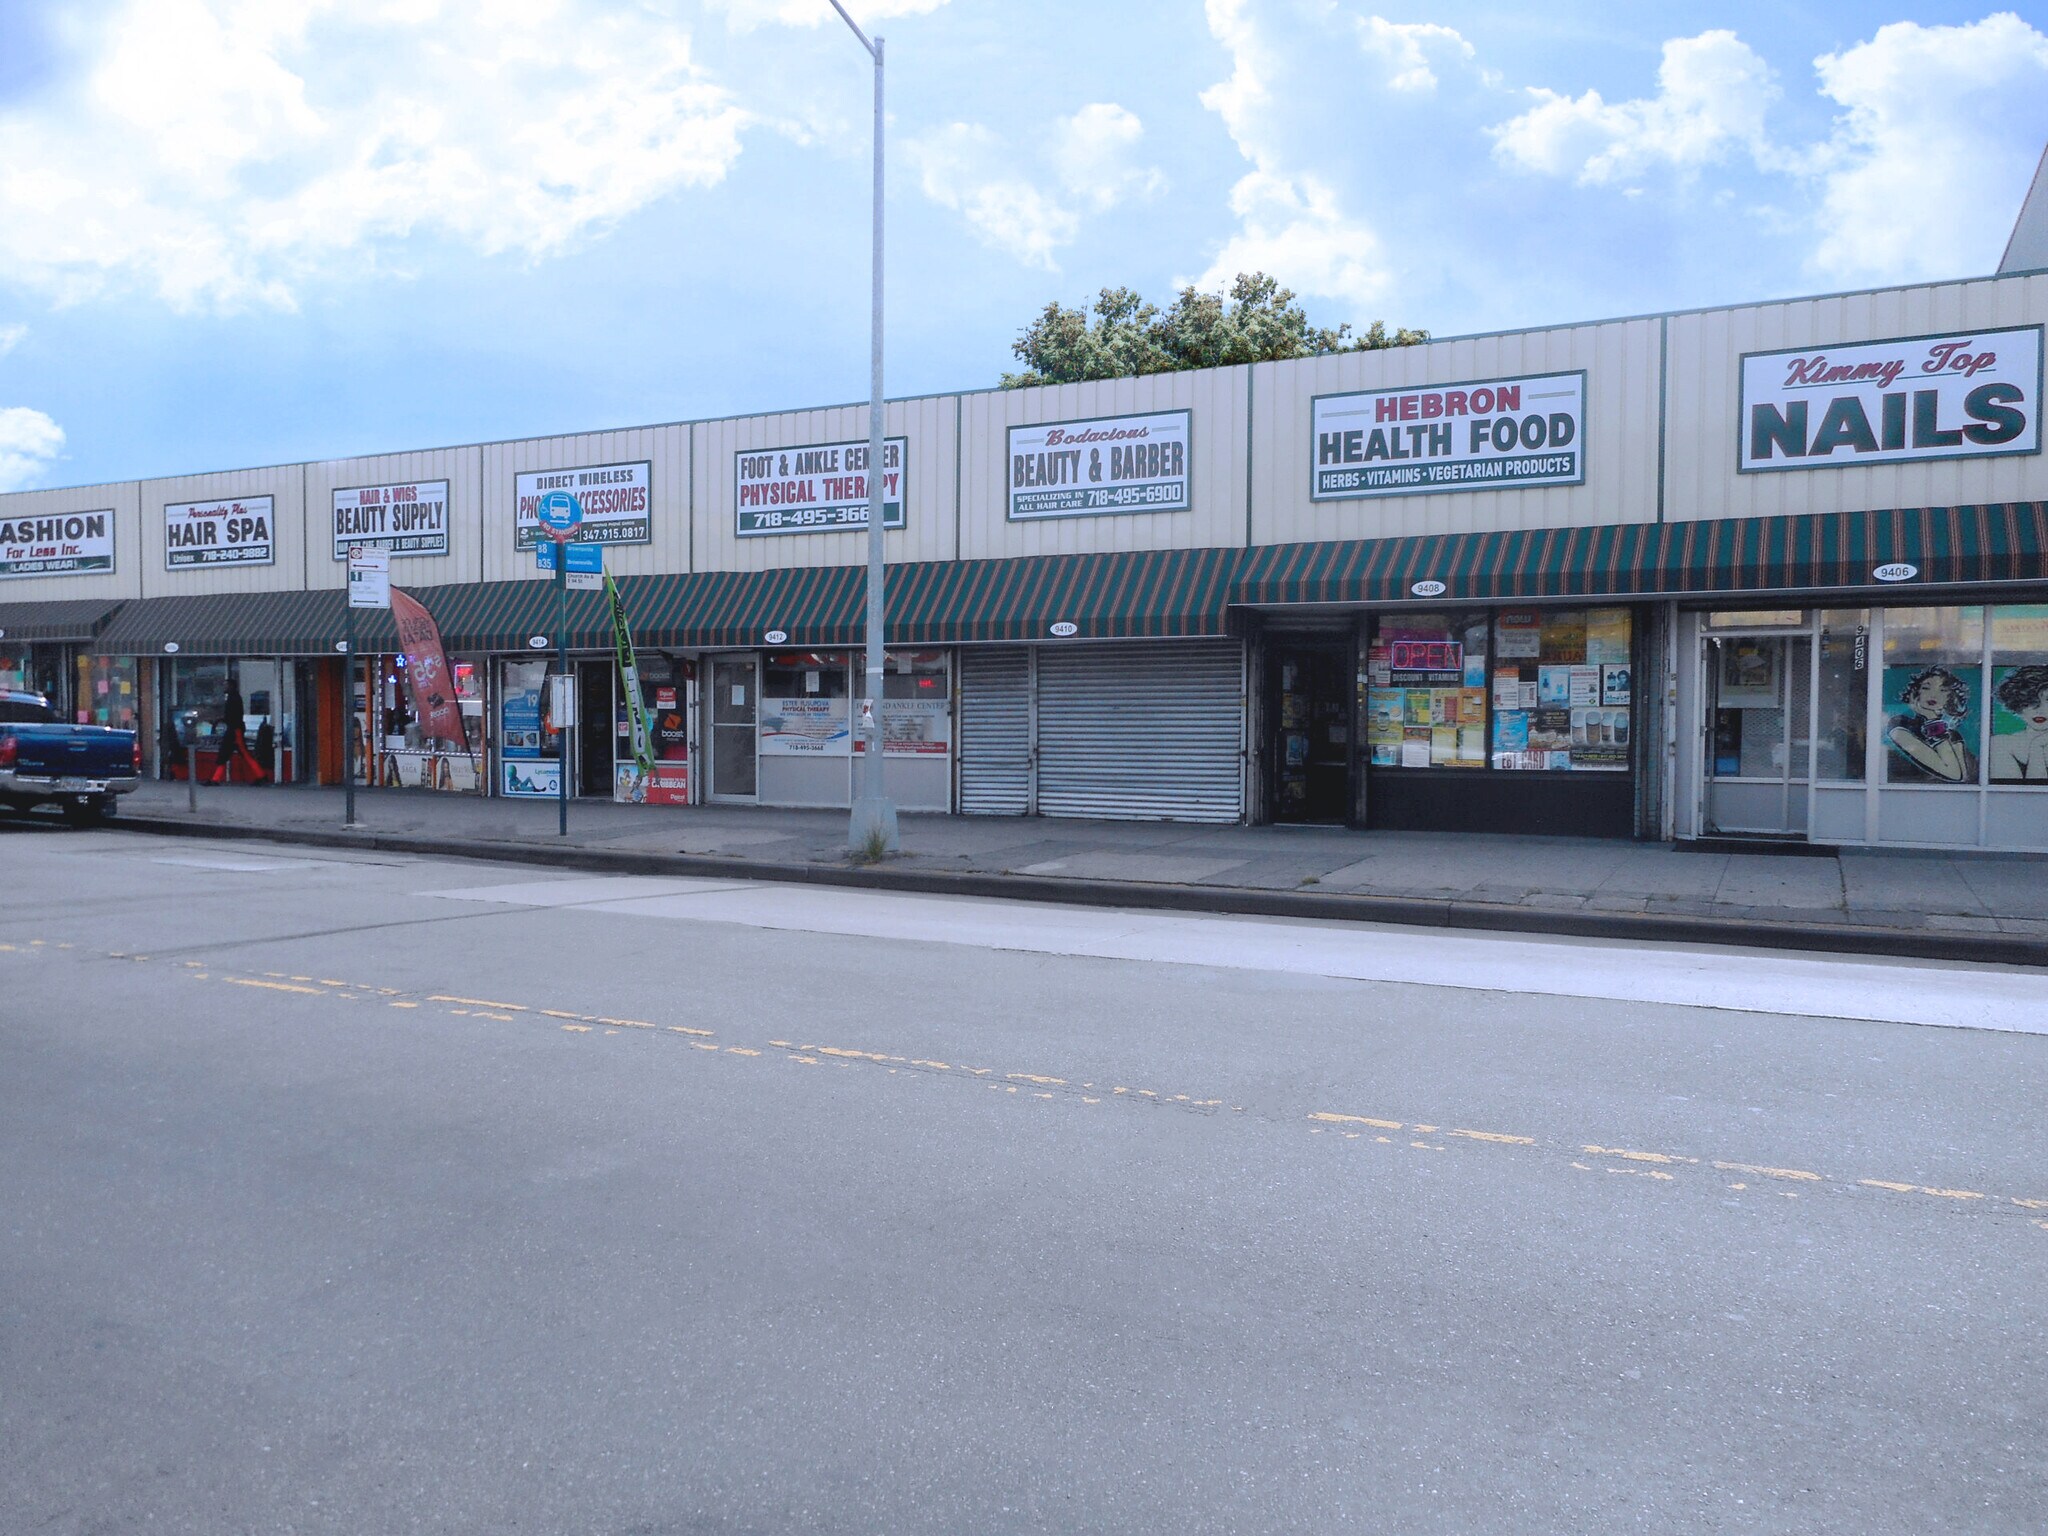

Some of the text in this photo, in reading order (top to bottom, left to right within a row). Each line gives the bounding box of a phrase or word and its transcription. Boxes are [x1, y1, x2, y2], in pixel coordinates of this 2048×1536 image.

[1783, 340, 1997, 389] Kimmy Top
[1375, 385, 1521, 423] HEBRON
[1750, 382, 2027, 460] NAILS
[1045, 426, 1149, 446] Bodacious
[1319, 412, 1575, 465] HEALTH FOOD
[740, 445, 899, 480] FOOT & ANKLE CENER
[1013, 441, 1183, 488] BEAUTY & BARBER
[537, 469, 633, 490] DIRECT WIRELESS
[1322, 456, 1571, 490] HERBS VITAMINS VEGETARIAN PRODUCTS
[360, 486, 417, 505] HAIR & WIGS
[740, 473, 899, 507] PHYSICAL THERY
[1016, 491, 1084, 503] SPECIALIZING IN
[1087, 484, 1181, 507] 718-495-6900
[1018, 500, 1083, 511] ALL HAIR CARE
[336, 501, 443, 534] BEAUTY SUPPLY
[754, 508, 869, 528] 718-495-366
[0, 515, 105, 544] ASHION
[168, 516, 269, 547] HAIR SPA
[582, 526, 645, 541] 347.915.0817
[6, 543, 82, 559] For Less Inc.
[537, 558, 552, 568] B35
[1881, 567, 1909, 577] 9406
[1417, 584, 1440, 592] 9408
[768, 633, 783, 641] 9412
[1055, 625, 1073, 633] 9410
[1394, 643, 1461, 669] OPEN
[661, 729, 684, 738] boost
[1522, 751, 1544, 769] CARD
